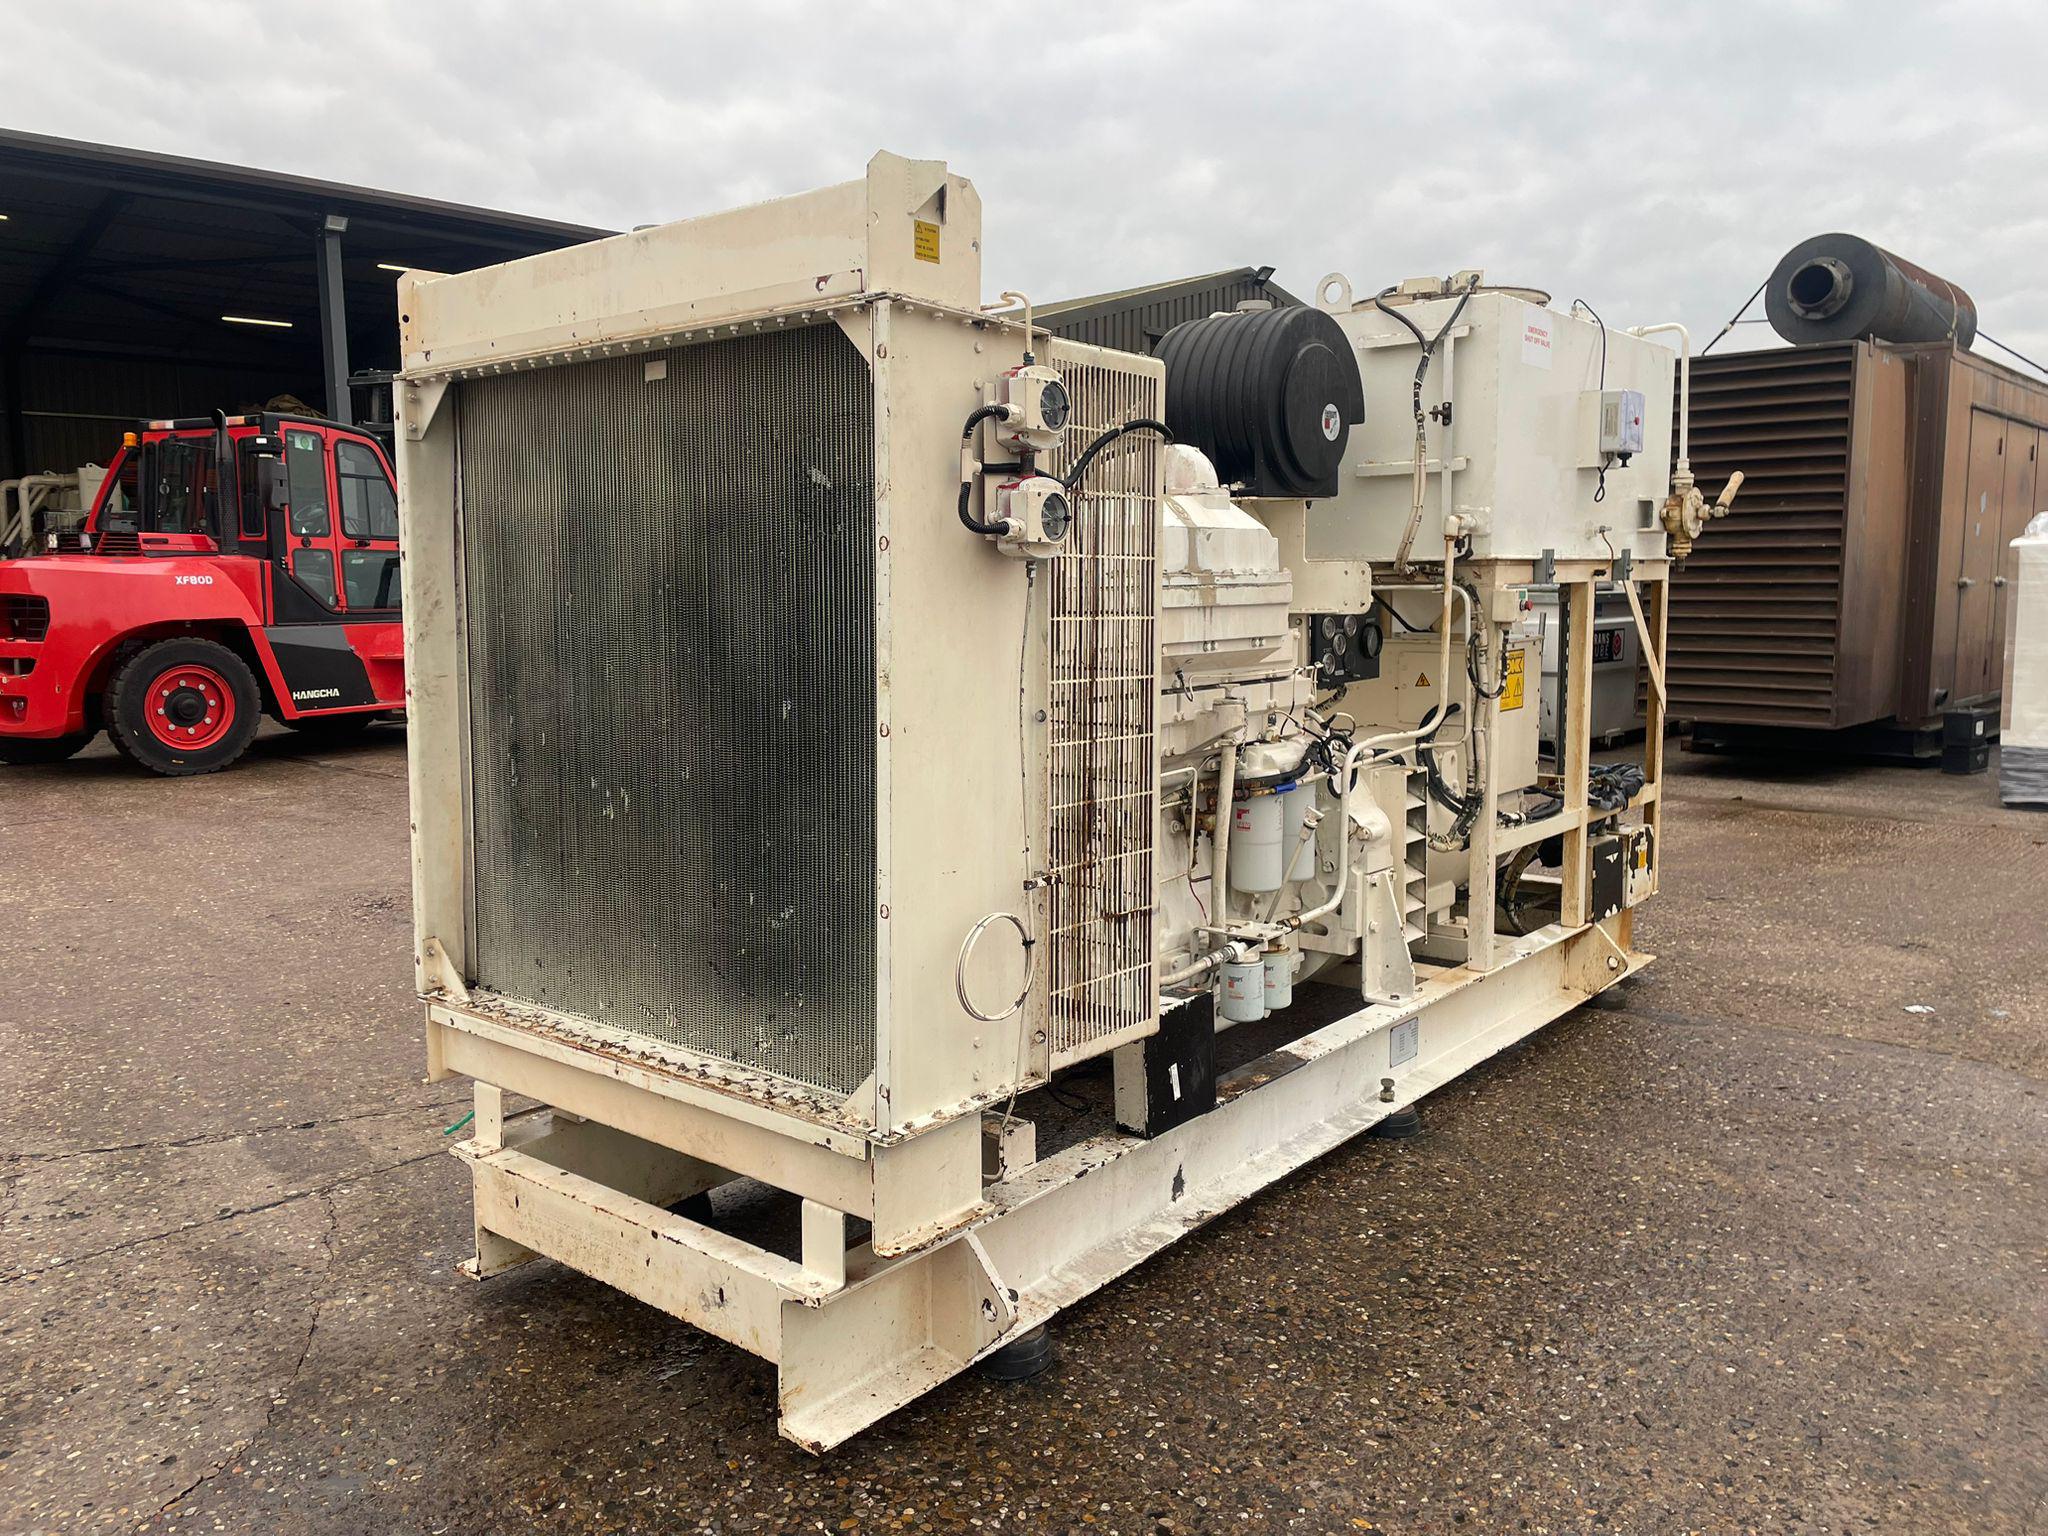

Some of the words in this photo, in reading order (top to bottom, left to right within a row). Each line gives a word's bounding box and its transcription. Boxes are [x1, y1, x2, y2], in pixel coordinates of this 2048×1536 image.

[174, 575, 214, 585] XF80D
[1594, 632, 1611, 645] RANS
[1594, 645, 1610, 657] UBE
[292, 688, 340, 700] HANGCHA
